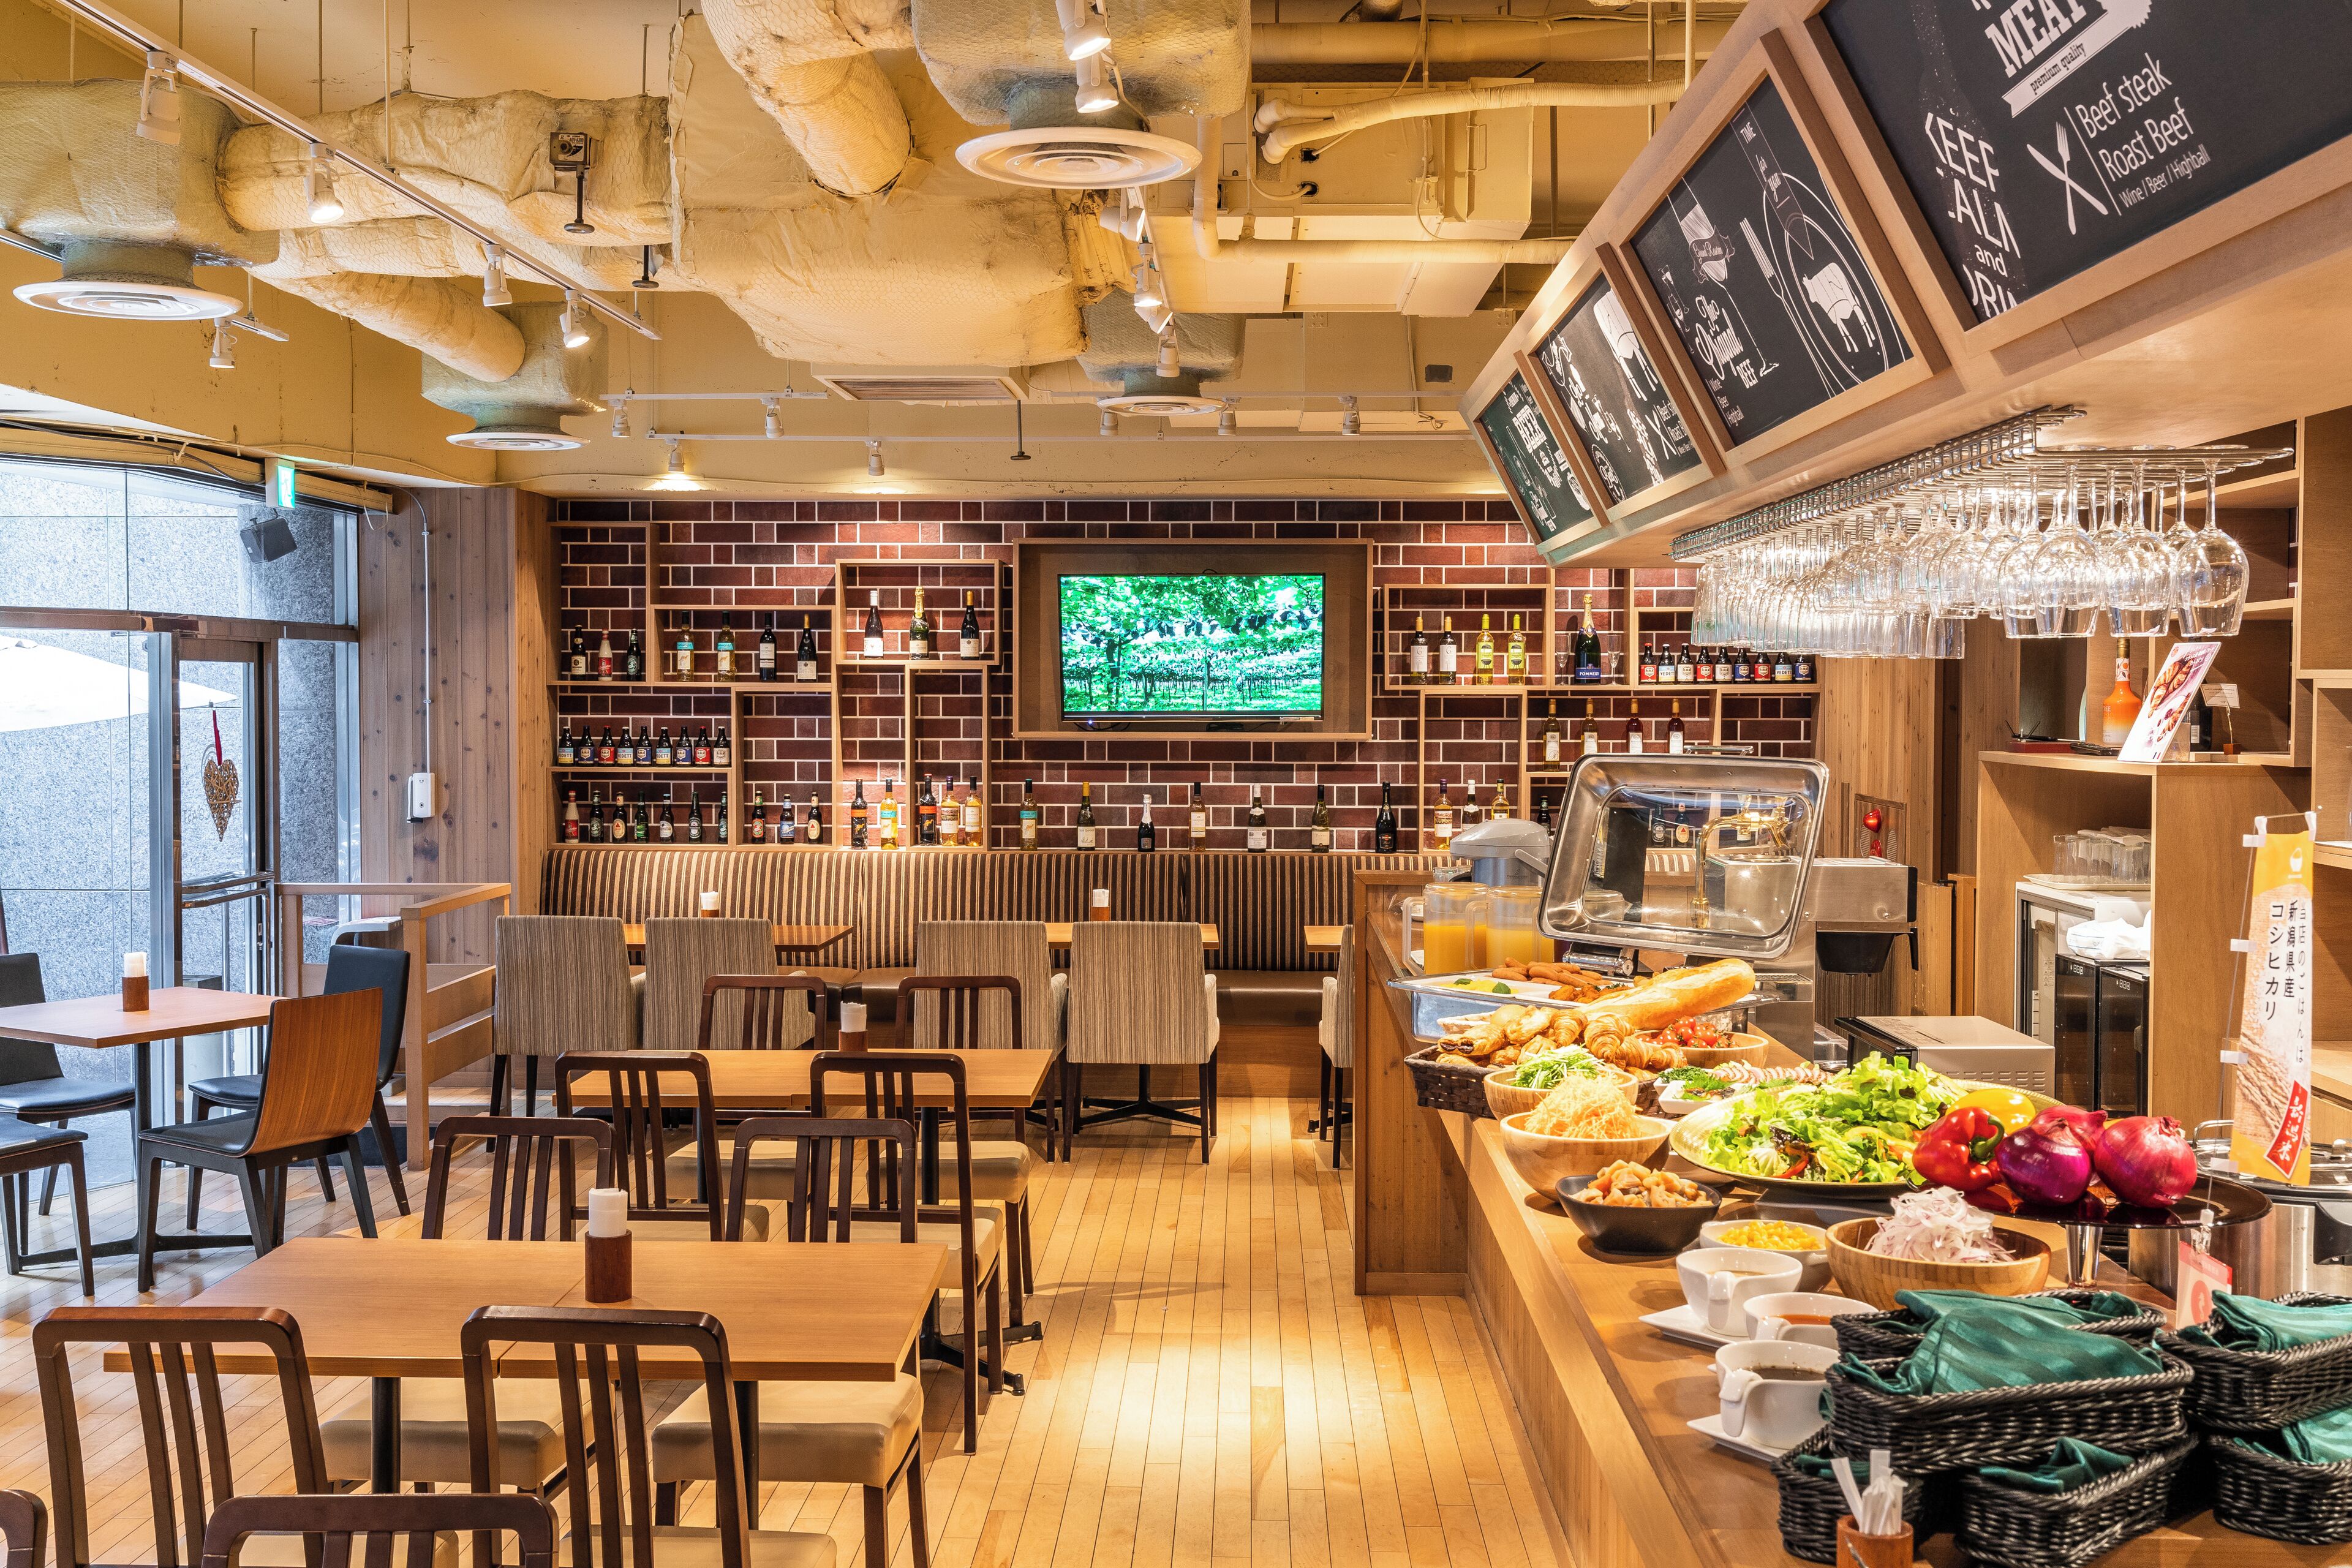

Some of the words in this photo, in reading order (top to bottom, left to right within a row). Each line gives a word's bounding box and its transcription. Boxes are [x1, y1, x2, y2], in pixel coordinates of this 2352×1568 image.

[2030, 63, 2062, 95] premium
[2060, 42, 2087, 73] quality
[2075, 82, 2121, 138] Beef
[2118, 53, 2172, 113] steak
[1740, 122, 1756, 144] TIME
[2098, 130, 2154, 181] Roast
[2144, 96, 2194, 153] Beef
[2119, 186, 2145, 208] Wine
[2146, 174, 2166, 196] Beer
[2173, 144, 2211, 179] Highball
[1974, 244, 2008, 277] and
[1695, 295, 1720, 331] The
[1695, 308, 1744, 380] Original
[1708, 378, 1722, 393] Wine
[1736, 359, 1758, 388] BEEF
[1656, 399, 1670, 421] Beef
[1717, 396, 1729, 409] Beer
[1726, 405, 1744, 426] Highball
[1512, 404, 1547, 454] BEER
[1667, 423, 1683, 442] Roast
[2265, 903, 2284, 1021] コシヒカリ
[2283, 900, 2298, 998] 新潟県産
